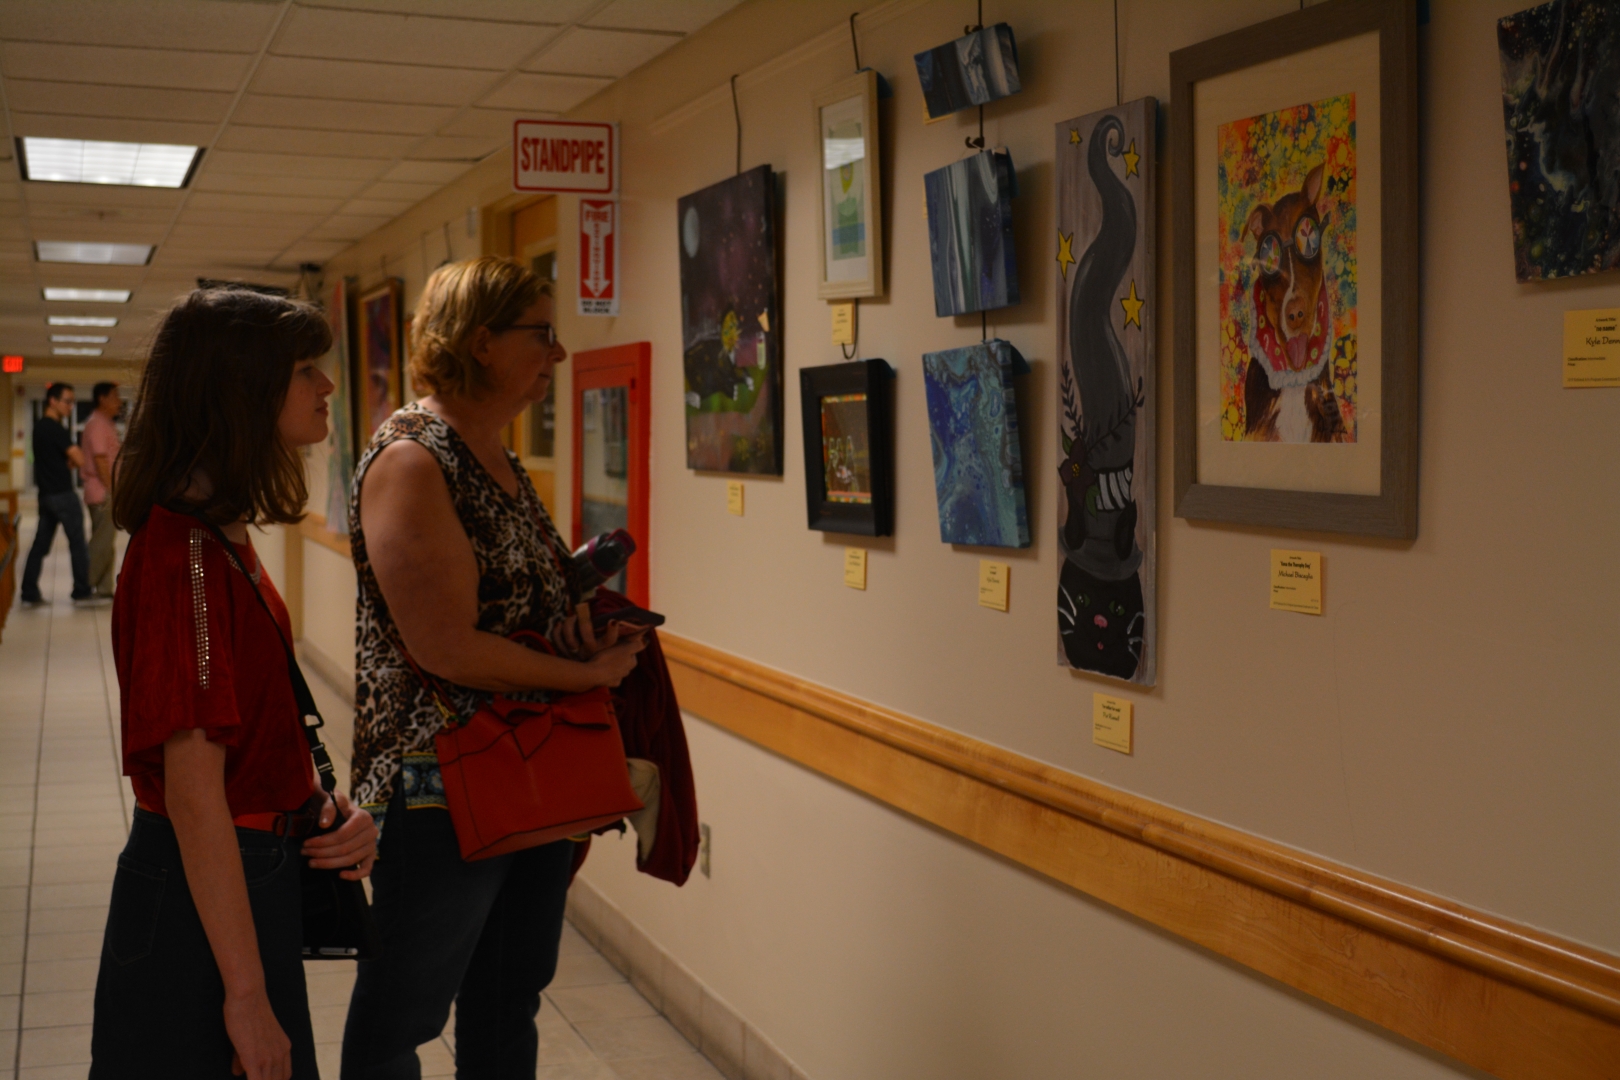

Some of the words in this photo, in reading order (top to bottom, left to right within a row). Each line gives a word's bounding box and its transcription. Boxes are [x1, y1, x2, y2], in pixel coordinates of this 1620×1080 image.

[521, 136, 604, 174] STANDPIPE
[585, 210, 609, 223] FIRE
[1586, 337, 1600, 347] Kyle
